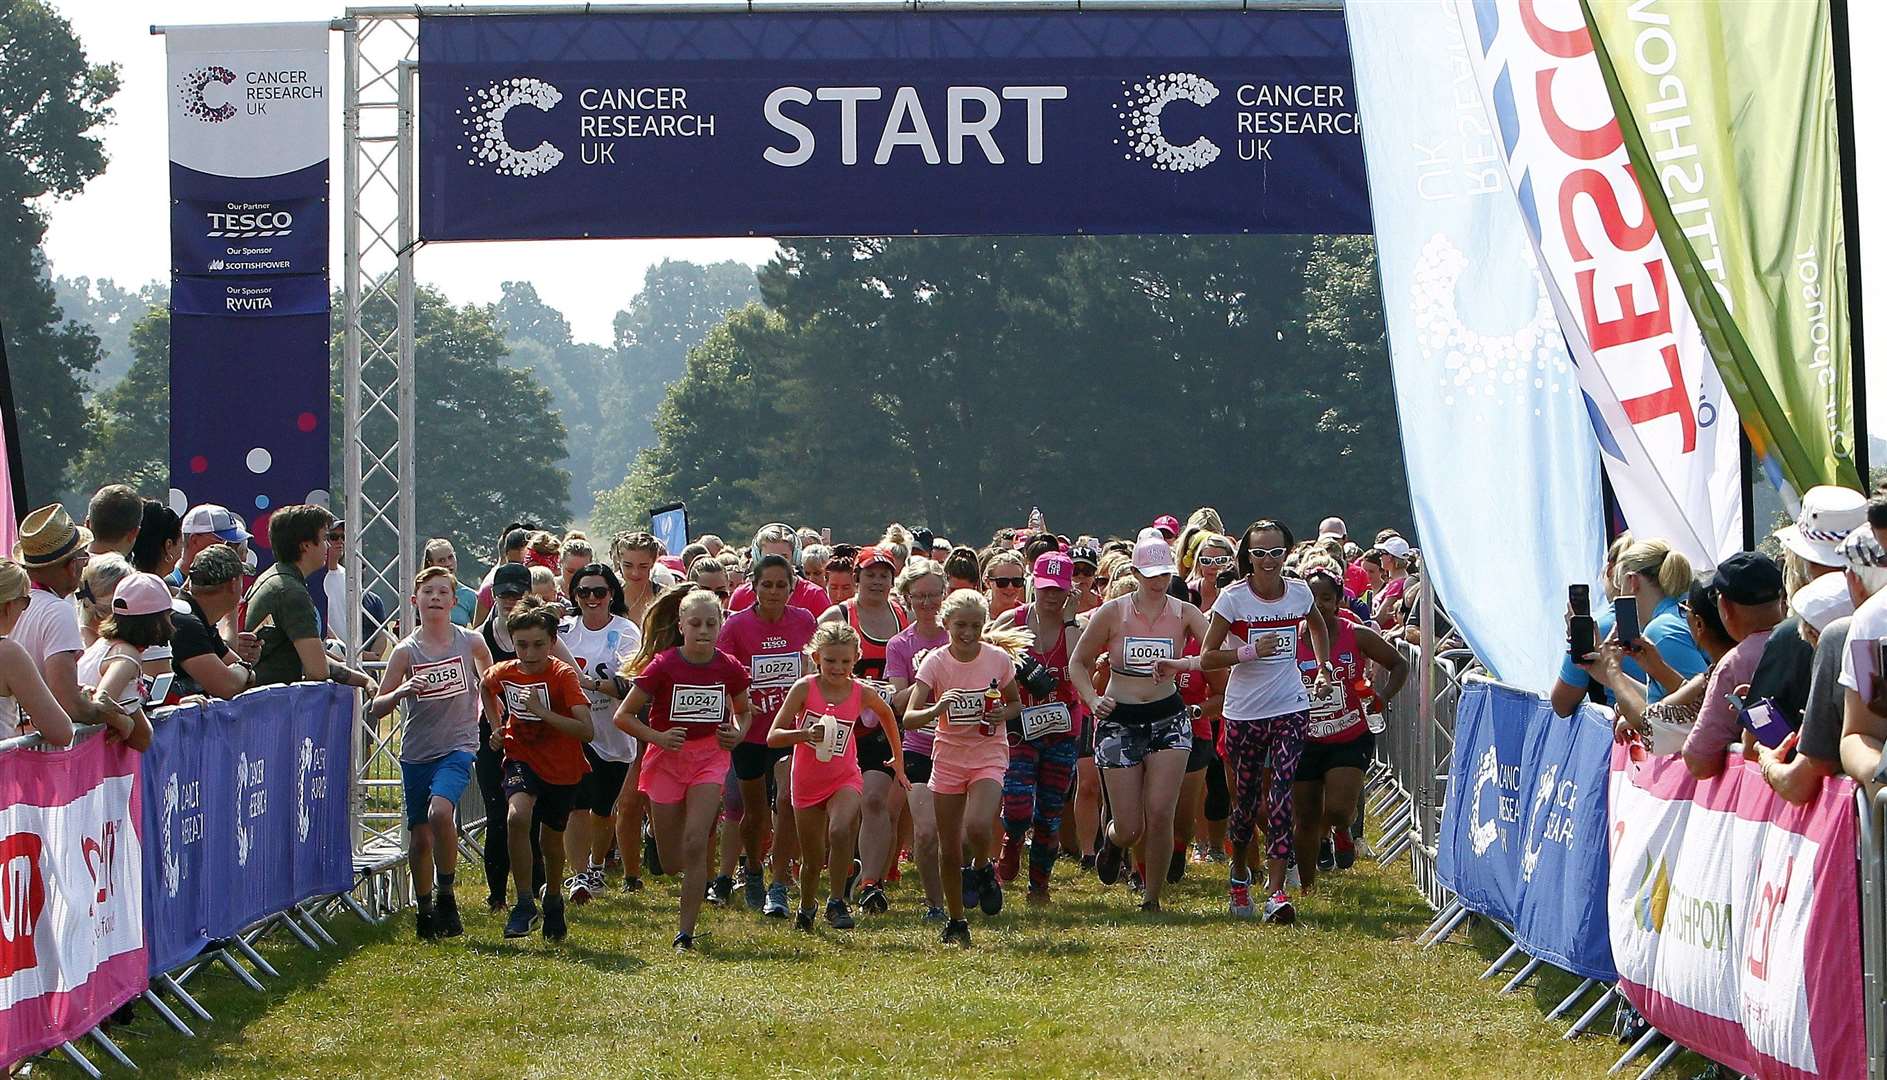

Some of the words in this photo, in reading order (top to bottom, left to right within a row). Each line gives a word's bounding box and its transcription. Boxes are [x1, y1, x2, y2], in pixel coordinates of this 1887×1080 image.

[246, 70, 307, 84] CANCER
[246, 85, 323, 100] RESEARCH
[579, 87, 688, 111] CANCER
[1236, 84, 1344, 107] CANCER
[246, 102, 267, 115] UK
[580, 114, 715, 137] RESEARCH
[762, 85, 1068, 167] START
[580, 142, 616, 165] UK
[1237, 139, 1273, 161] UK
[227, 202, 242, 211] Our
[243, 201, 270, 211] Partner
[207, 211, 293, 231] TESCO
[226, 246, 241, 255] Our
[242, 246, 273, 258] Sponsor
[225, 260, 291, 270] SCOTTISHPOWER
[226, 286, 242, 295] Our
[242, 286, 273, 297] Sponsor
[1072, 546, 1091, 558] NY
[761, 639, 787, 648] TESCO
[1130, 647, 1166, 658] 10041
[759, 662, 794, 674] 10272
[428, 668, 458, 684] 0158
[679, 695, 718, 706] 10247
[953, 698, 983, 710] 1014
[1029, 711, 1063, 728] 10133
[1499, 763, 1521, 791] CANC
